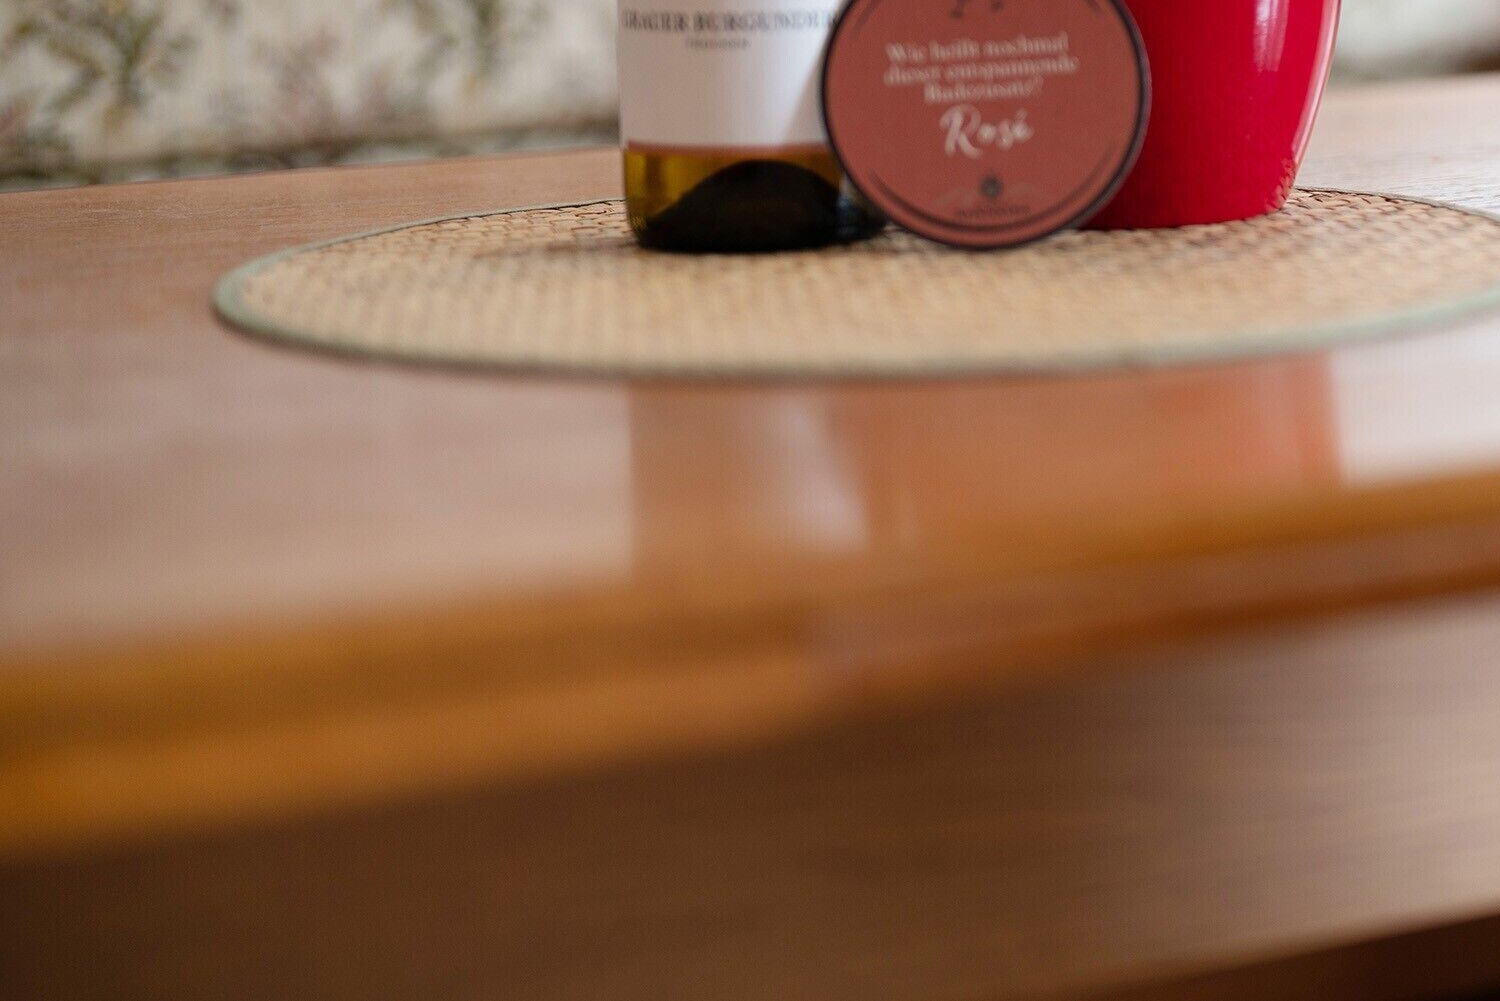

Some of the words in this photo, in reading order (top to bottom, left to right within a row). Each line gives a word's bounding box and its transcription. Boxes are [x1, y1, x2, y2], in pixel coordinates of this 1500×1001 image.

[886, 42, 924, 62] Wie
[983, 31, 1068, 55] nochmal
[939, 103, 1033, 159] Rosé
